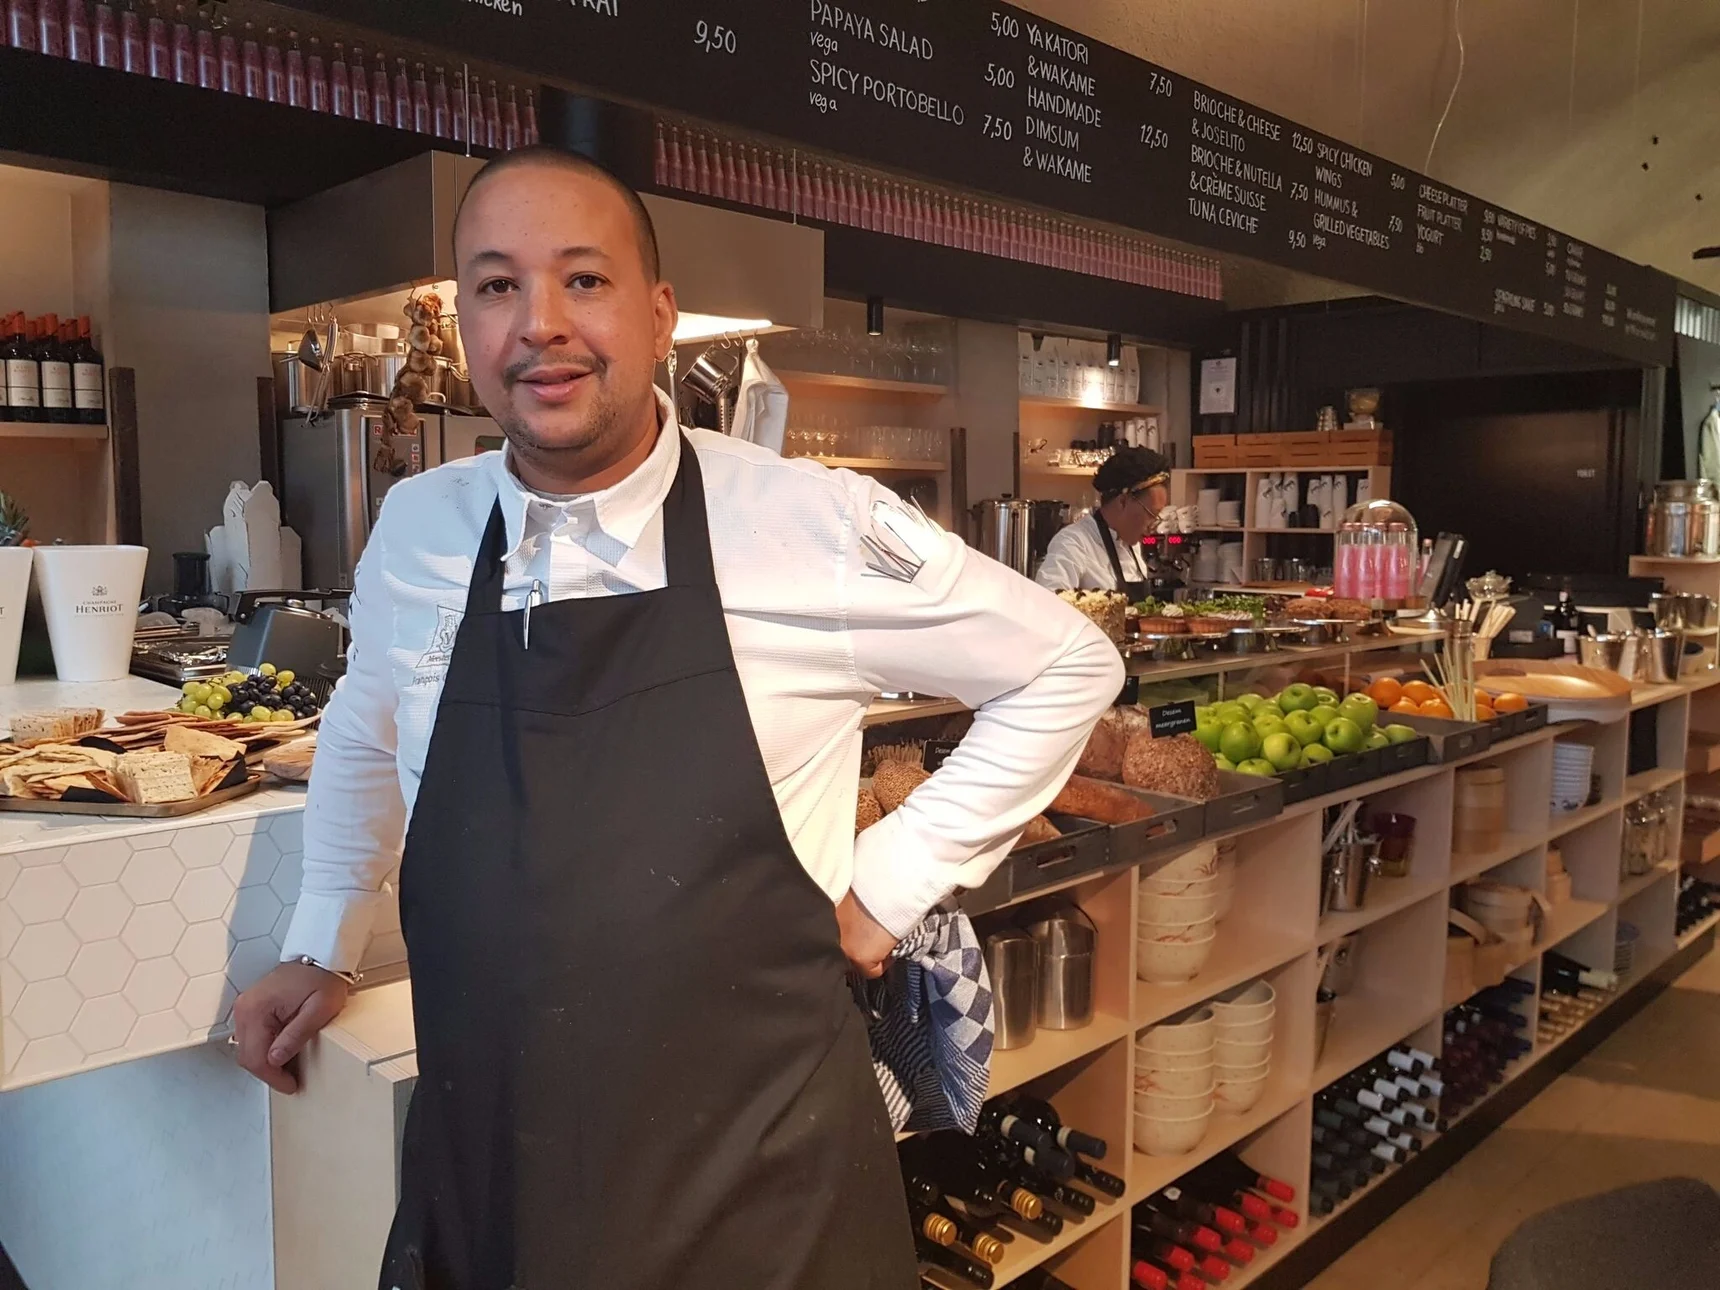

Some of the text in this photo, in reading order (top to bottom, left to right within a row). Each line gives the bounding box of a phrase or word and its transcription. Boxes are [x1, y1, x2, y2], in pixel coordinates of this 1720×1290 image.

[694, 20, 737, 53] 9,50
[811, 0, 933, 60] PAPAYA SALAD
[991, 12, 1019, 38] 5,00
[810, 31, 838, 56] vega
[984, 63, 1015, 88] 5,00
[1150, 73, 1173, 97] 7,50
[809, 91, 838, 113] vega
[810, 59, 964, 125] SPICY PORTOBELLO
[1028, 85, 1102, 128] HANDMADE
[1193, 90, 1237, 123] BRIOCHE
[1247, 114, 1281, 141] CHEESE
[982, 114, 1012, 140] 7,50
[1026, 116, 1079, 152] DIMSUM
[1140, 124, 1169, 149] 12,50
[1191, 118, 1246, 152] & JOSELITO
[1292, 132, 1313, 154] 12,50
[1023, 146, 1092, 183] & WAKAME
[1191, 144, 1234, 175] BRIOCHE
[1243, 163, 1283, 192] NUTELLA
[1316, 142, 1373, 177] SPICY CHICKEN
[1315, 165, 1342, 189] WINGS
[1234, 186, 1267, 212] SUISSE
[1290, 182, 1309, 201] 7,50
[1314, 188, 1358, 218] HUMMUS &
[1188, 198, 1259, 234] TUNA CEVICHE
[1288, 230, 1306, 249] 9,50
[1313, 212, 1390, 250] GRILLED VEGETABLES
[1416, 223, 1444, 246] YOGURT
[76, 604, 123, 614] HENRIOT
